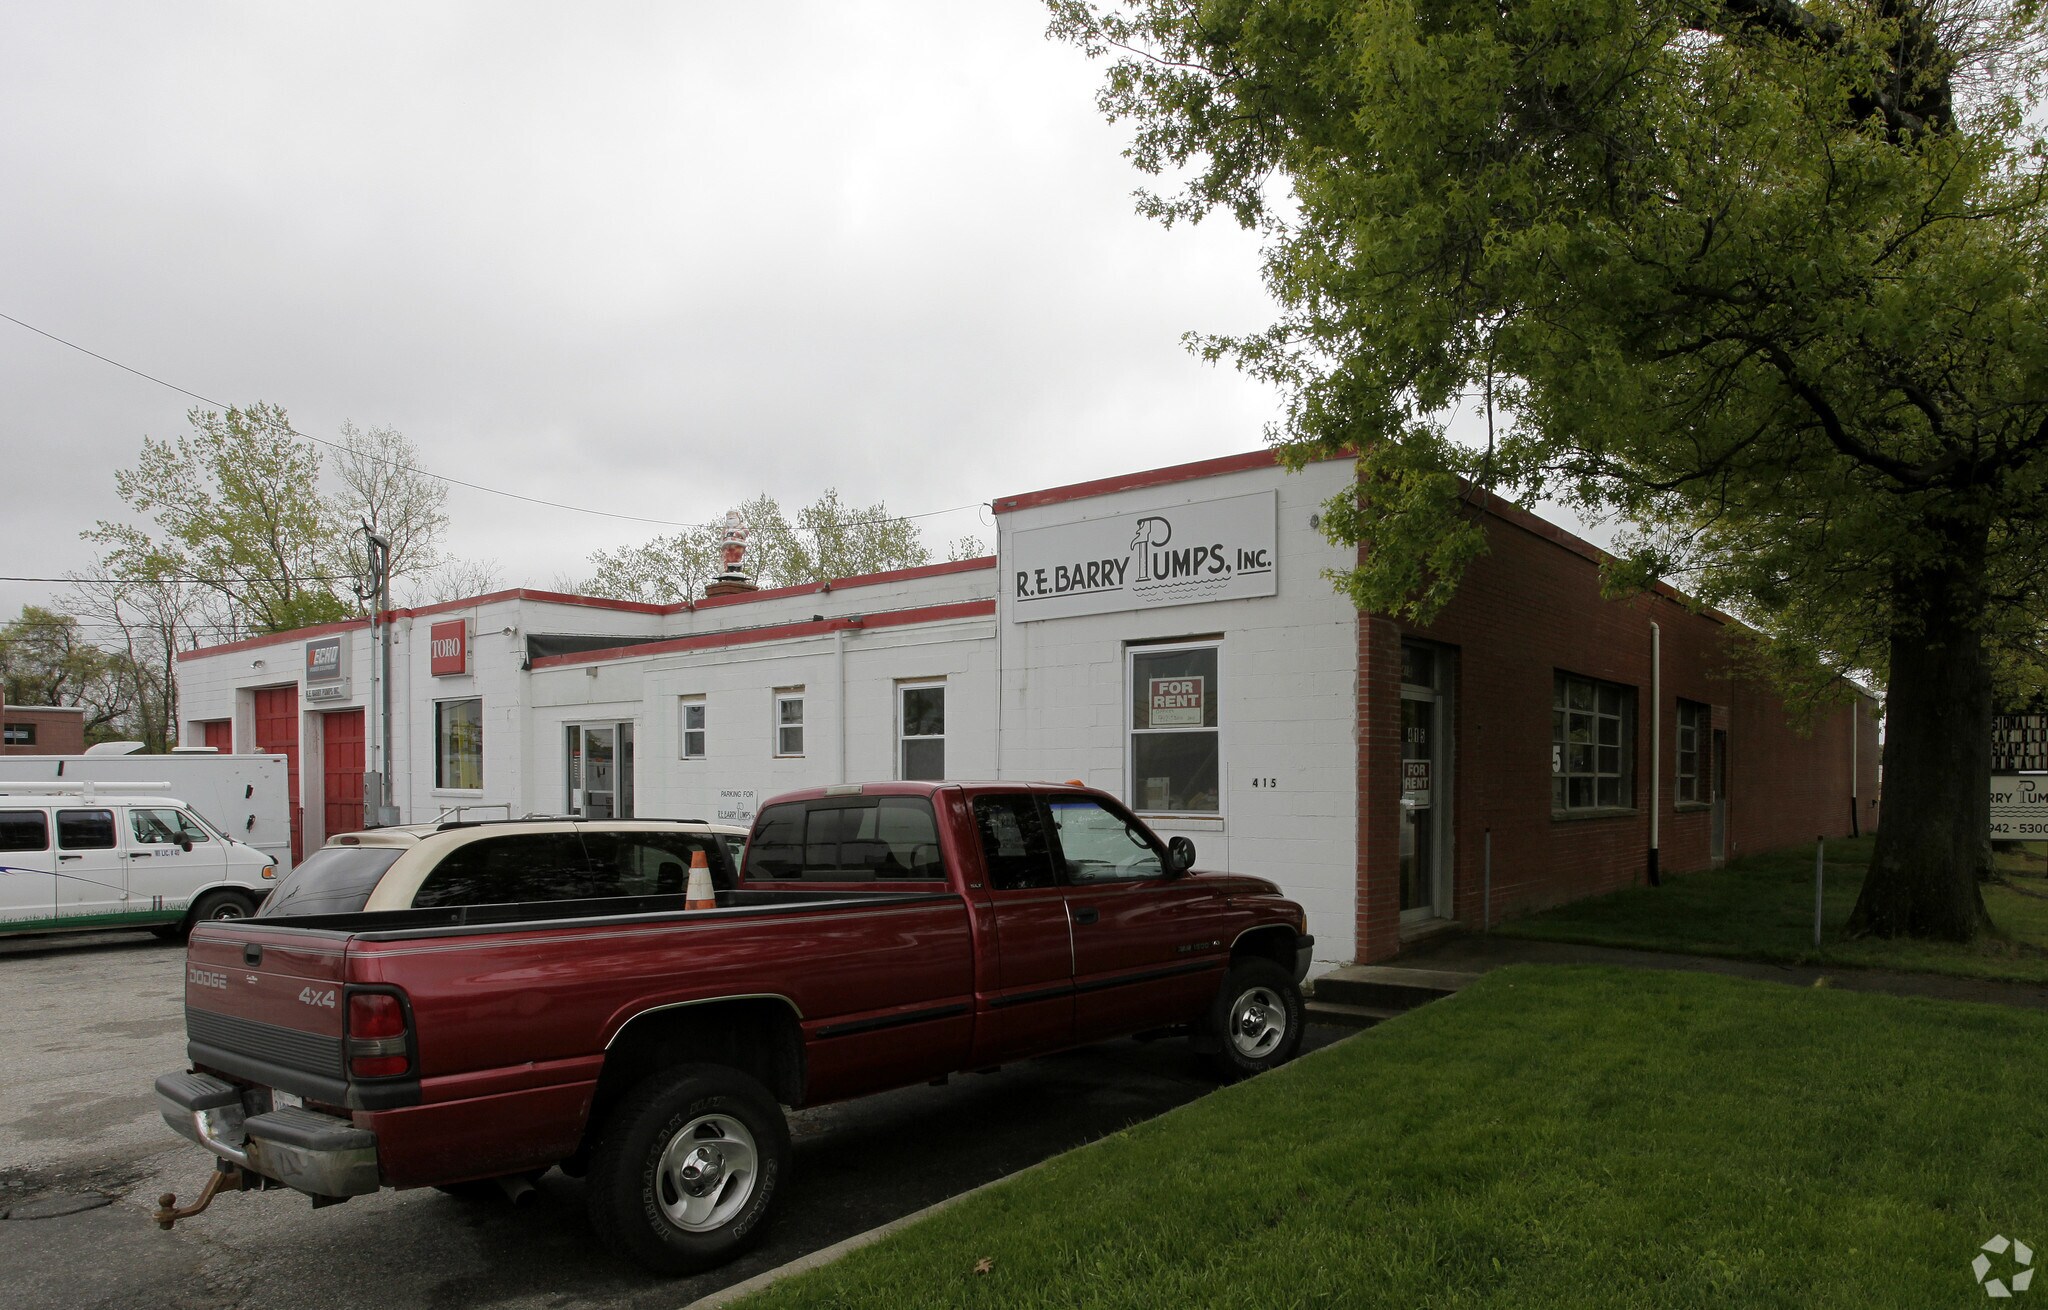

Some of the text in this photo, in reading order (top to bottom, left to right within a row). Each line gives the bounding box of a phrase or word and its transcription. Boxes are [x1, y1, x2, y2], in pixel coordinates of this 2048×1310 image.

[431, 637, 460, 659] TORO
[314, 646, 338, 665] ECHO
[1159, 681, 1193, 694] FOR
[1153, 694, 1199, 707] RENT
[1408, 763, 1425, 776] FOR
[1252, 777, 1277, 788] 415
[1405, 777, 1429, 789] RENT
[721, 790, 753, 798] PARKING FOR
[189, 968, 228, 990] DODGE
